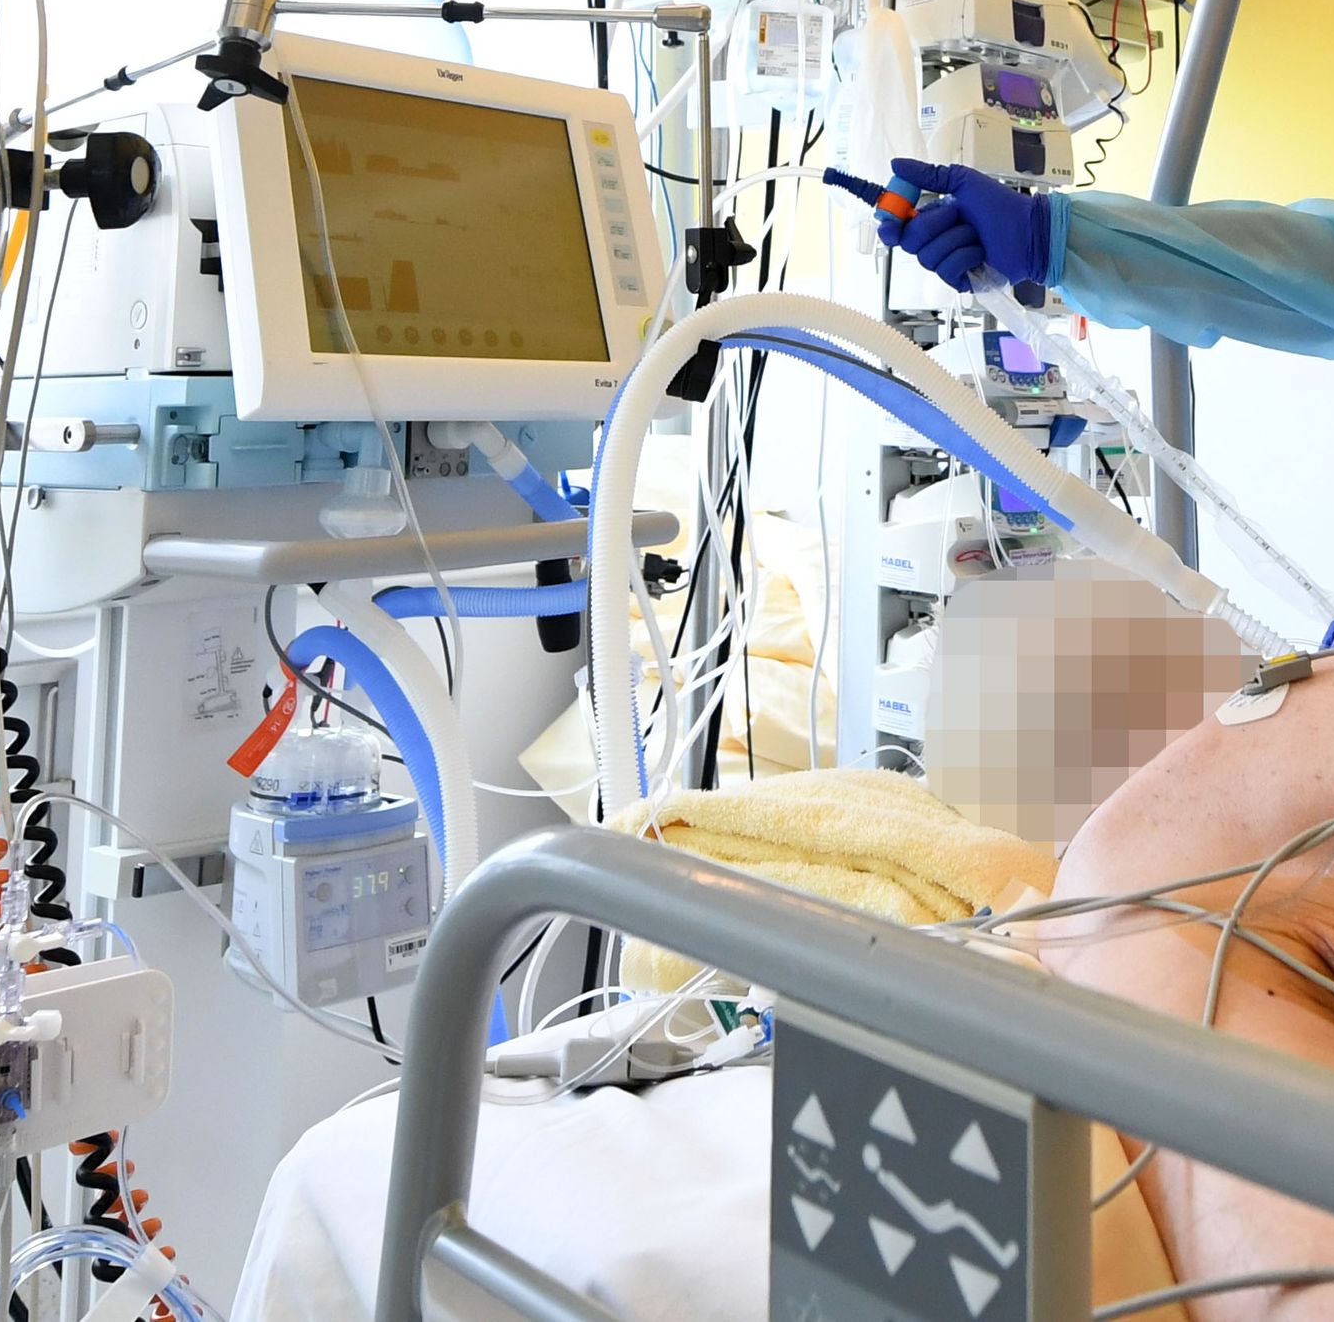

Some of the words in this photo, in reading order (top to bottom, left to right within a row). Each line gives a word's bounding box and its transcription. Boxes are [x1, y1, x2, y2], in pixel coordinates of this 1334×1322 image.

[594, 378, 612, 389] Evita
[881, 555, 915, 571] HABEL
[878, 697, 913, 714] HABEL
